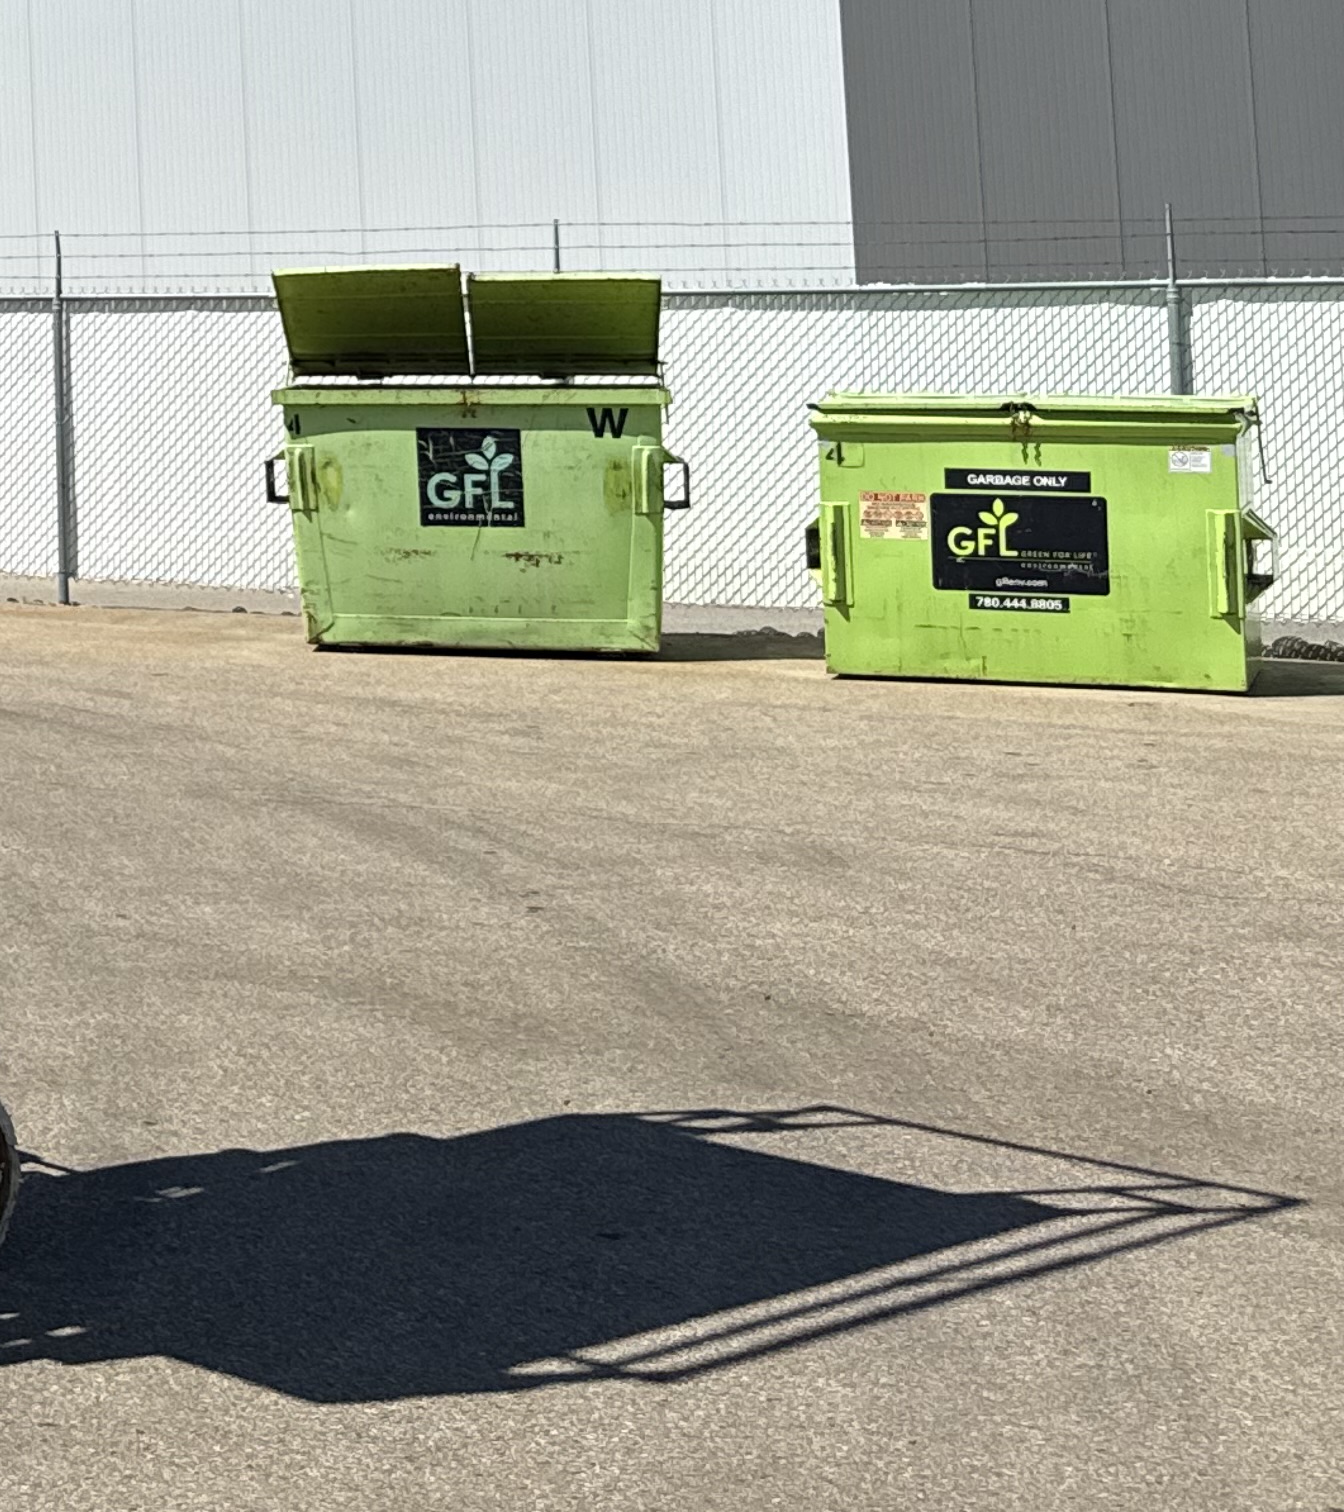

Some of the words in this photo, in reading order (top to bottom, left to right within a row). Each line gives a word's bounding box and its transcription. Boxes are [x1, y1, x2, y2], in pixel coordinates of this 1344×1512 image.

[587, 407, 629, 439] W
[427, 453, 516, 509] GFL
[967, 474, 1031, 487] GARBAGE
[1033, 475, 1068, 488] ONLY
[947, 513, 1019, 557] GFL
